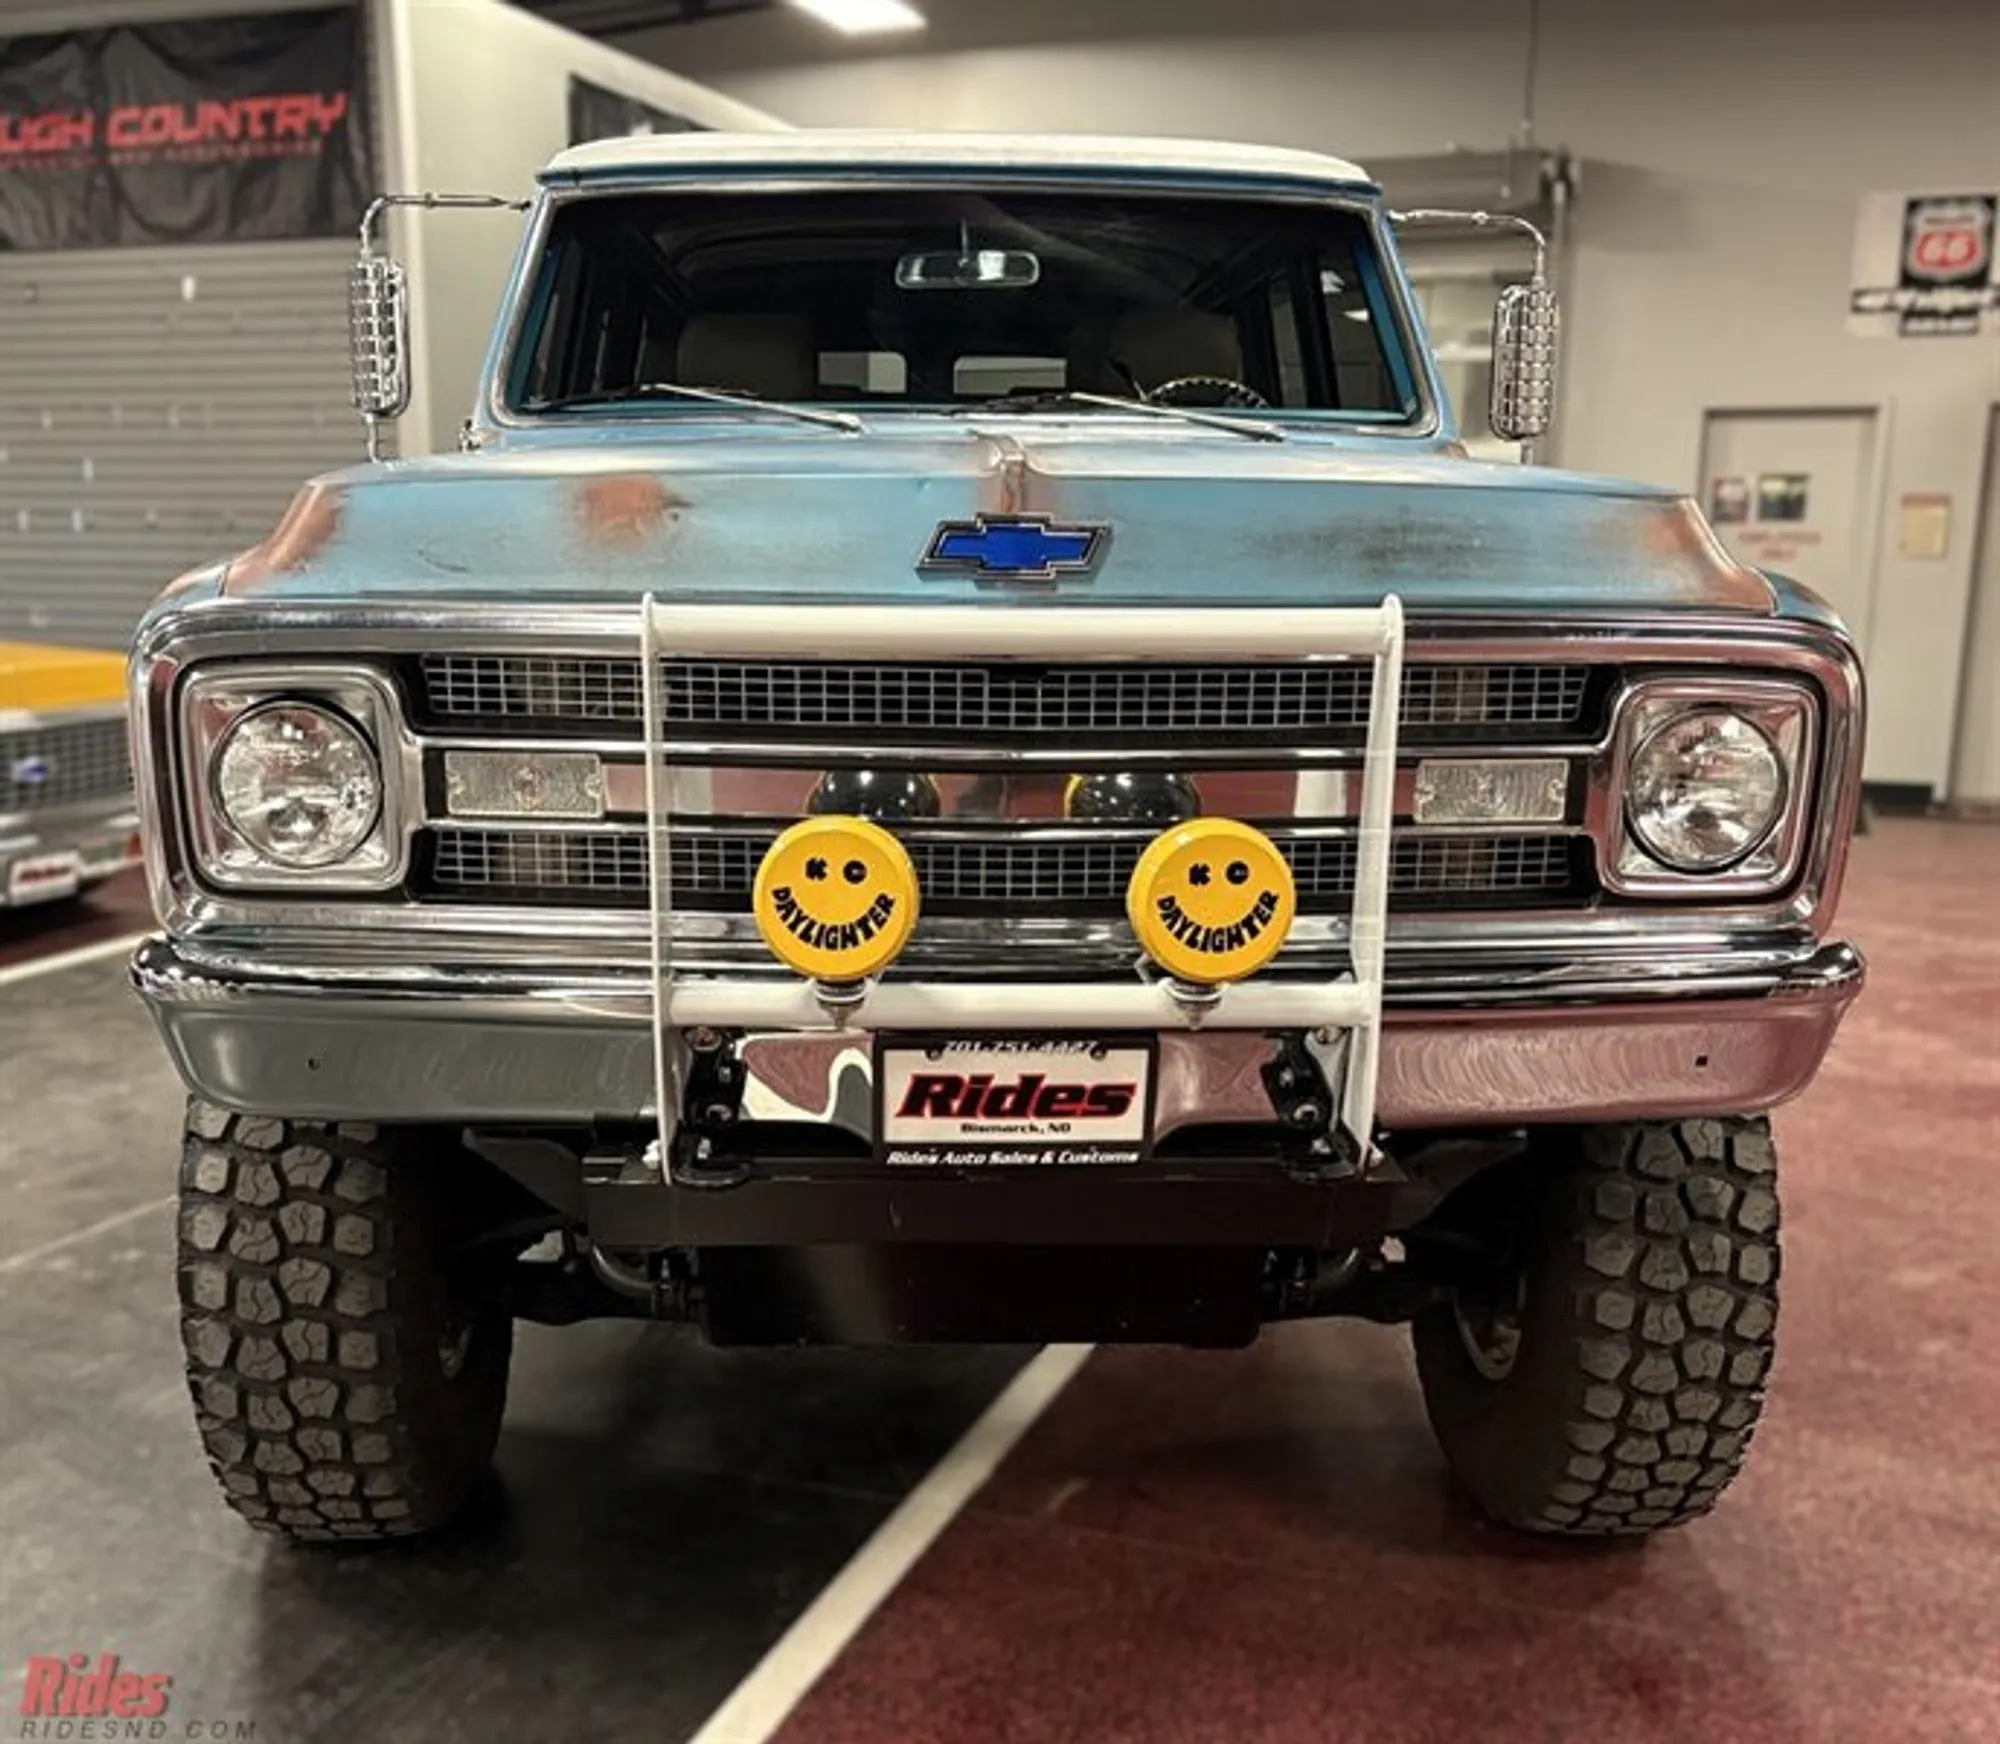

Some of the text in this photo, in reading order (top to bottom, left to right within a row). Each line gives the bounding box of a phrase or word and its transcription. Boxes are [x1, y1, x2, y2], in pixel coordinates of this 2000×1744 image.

[106, 91, 348, 148] COUNTRY
[1920, 233, 1971, 265] 66
[772, 886, 896, 951] DAYLIGHTER
[1157, 890, 1280, 953] DAYLIGHTER
[895, 1073, 1138, 1119] Rides
[961, 1122, 1071, 1135] Bismarck, ND
[887, 1149, 1140, 1164] Rides Auto Sales & Customs
